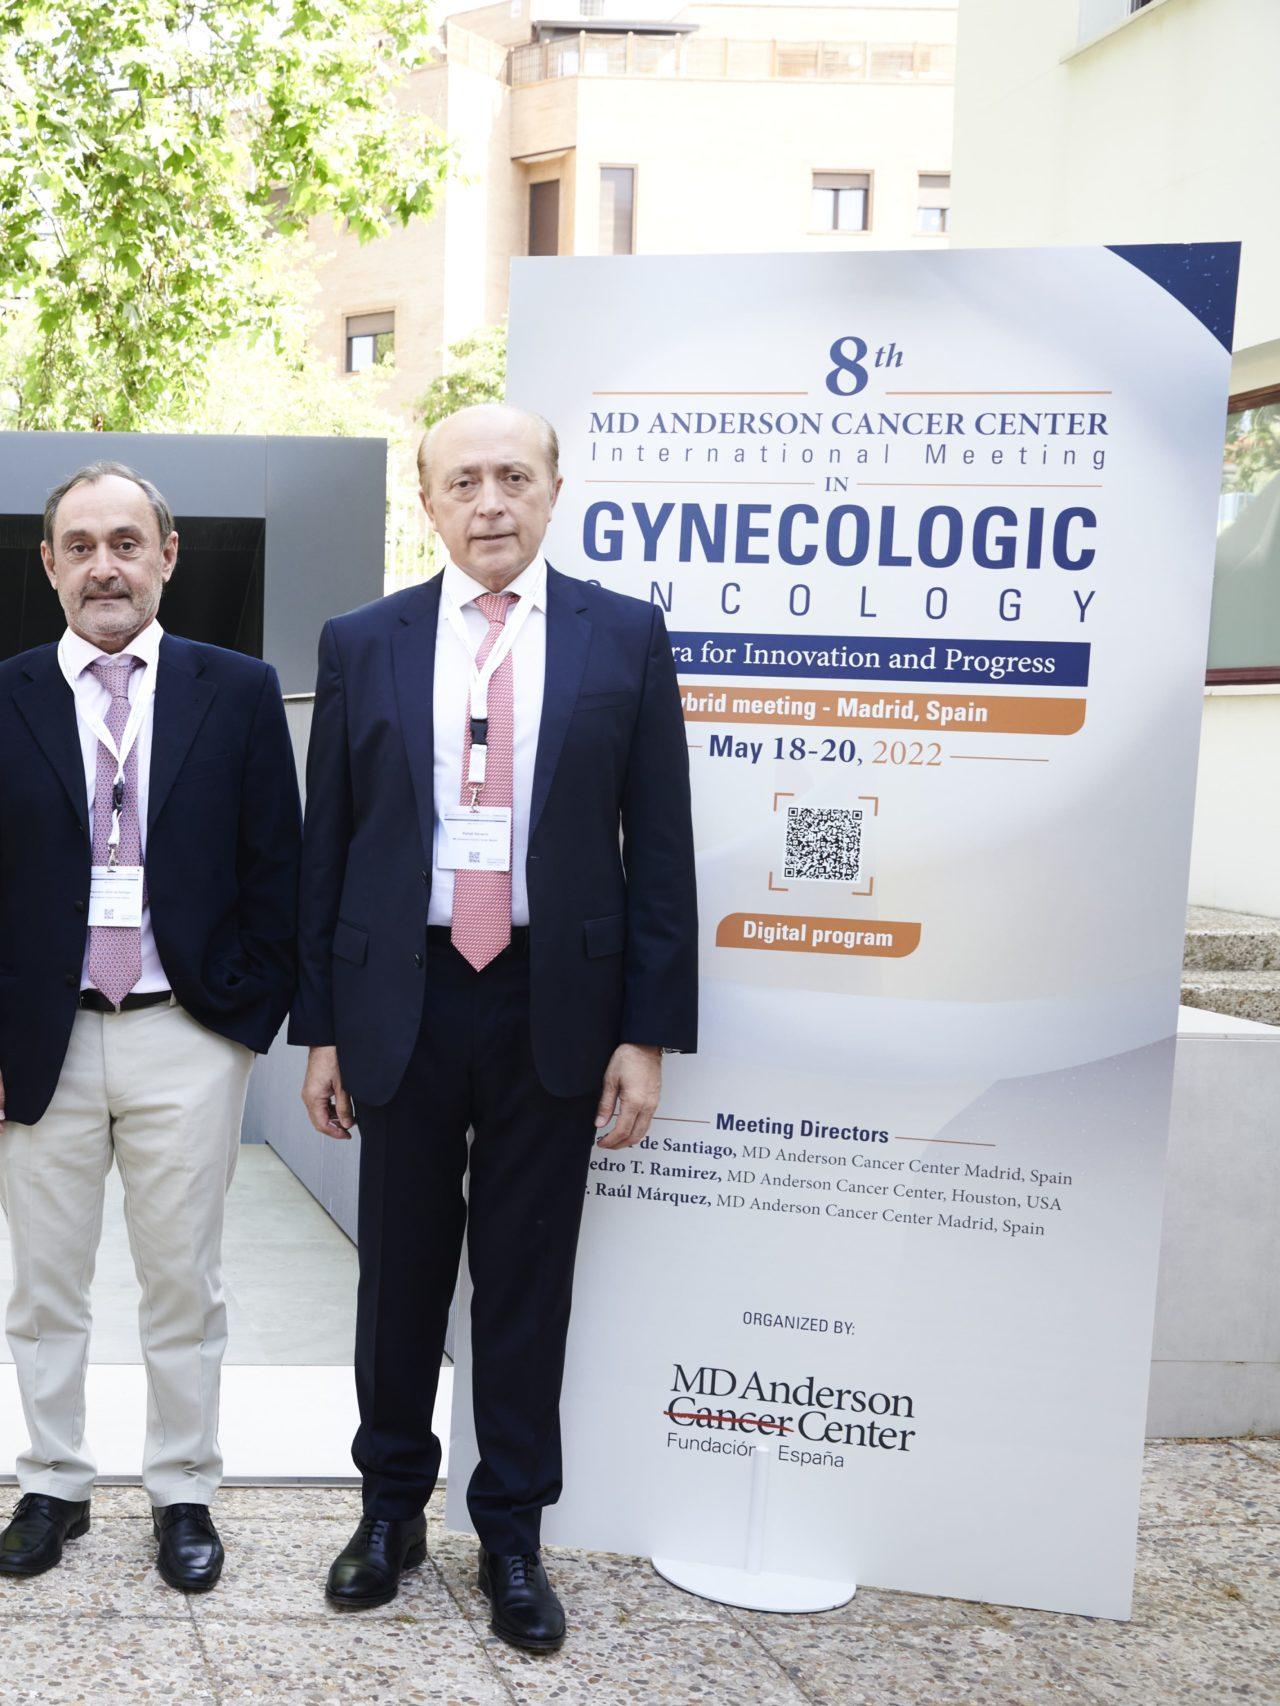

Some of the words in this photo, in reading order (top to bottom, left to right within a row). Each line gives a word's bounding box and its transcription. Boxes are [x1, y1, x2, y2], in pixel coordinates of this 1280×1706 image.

[589, 413, 639, 433] MD
[648, 413, 823, 434] ANDERSON
[832, 413, 965, 435] CANCER
[975, 413, 1108, 435] CENTER
[592, 442, 888, 463] International
[926, 444, 1105, 470] Meeting
[825, 477, 848, 491] IN
[583, 501, 1096, 571] GYNECOLOGIC
[586, 579, 1096, 624] NCOLOGY
[671, 646, 694, 663] ra
[701, 641, 736, 663] for
[743, 643, 880, 667] Innovation
[889, 647, 936, 669] and
[944, 649, 1055, 679] Progress
[733, 696, 816, 720] meeting
[837, 698, 919, 721] Madrid,
[926, 701, 987, 726] Spain
[710, 735, 762, 764] May
[774, 738, 862, 765] 18-20,
[872, 741, 941, 766] 2022
[744, 921, 806, 943] Digital
[812, 930, 892, 948] program
[717, 1113, 793, 1139] Meeting
[801, 1120, 888, 1143] Directors
[639, 1135, 659, 1150] de
[663, 1138, 736, 1159] Santiago,
[743, 1146, 770, 1158] MD
[775, 1149, 846, 1166] Anderson
[852, 1155, 904, 1170] Cancer
[909, 1160, 960, 1175] Center
[965, 1164, 1024, 1182] Madrid,
[1031, 1170, 1072, 1186] Spain
[589, 1157, 626, 1173] edro
[631, 1160, 644, 1174] T.
[650, 1162, 721, 1182] Ramirez,
[728, 1170, 755, 1183] MD
[760, 1173, 830, 1190] Anderson
[837, 1180, 888, 1195] Cancer
[894, 1184, 946, 1201] Center,
[952, 1189, 1020, 1208] Houston,
[1028, 1196, 1061, 1210] USA
[595, 1183, 631, 1198] Raúl
[637, 1186, 711, 1207] Márquez,
[717, 1194, 744, 1207] MD
[750, 1198, 820, 1215] Anderson
[826, 1204, 878, 1220] Cancer
[882, 1209, 933, 1225] Center
[938, 1214, 997, 1232] Madrid,
[1003, 1220, 1044, 1237] Spain
[743, 1312, 828, 1332] ORGANIZED
[834, 1321, 854, 1335] BY:
[670, 1363, 737, 1397] MD
[738, 1370, 916, 1419] Anderson
[666, 1396, 794, 1438] Cancer
[797, 1410, 917, 1453] Center
[778, 1444, 844, 1468] España
